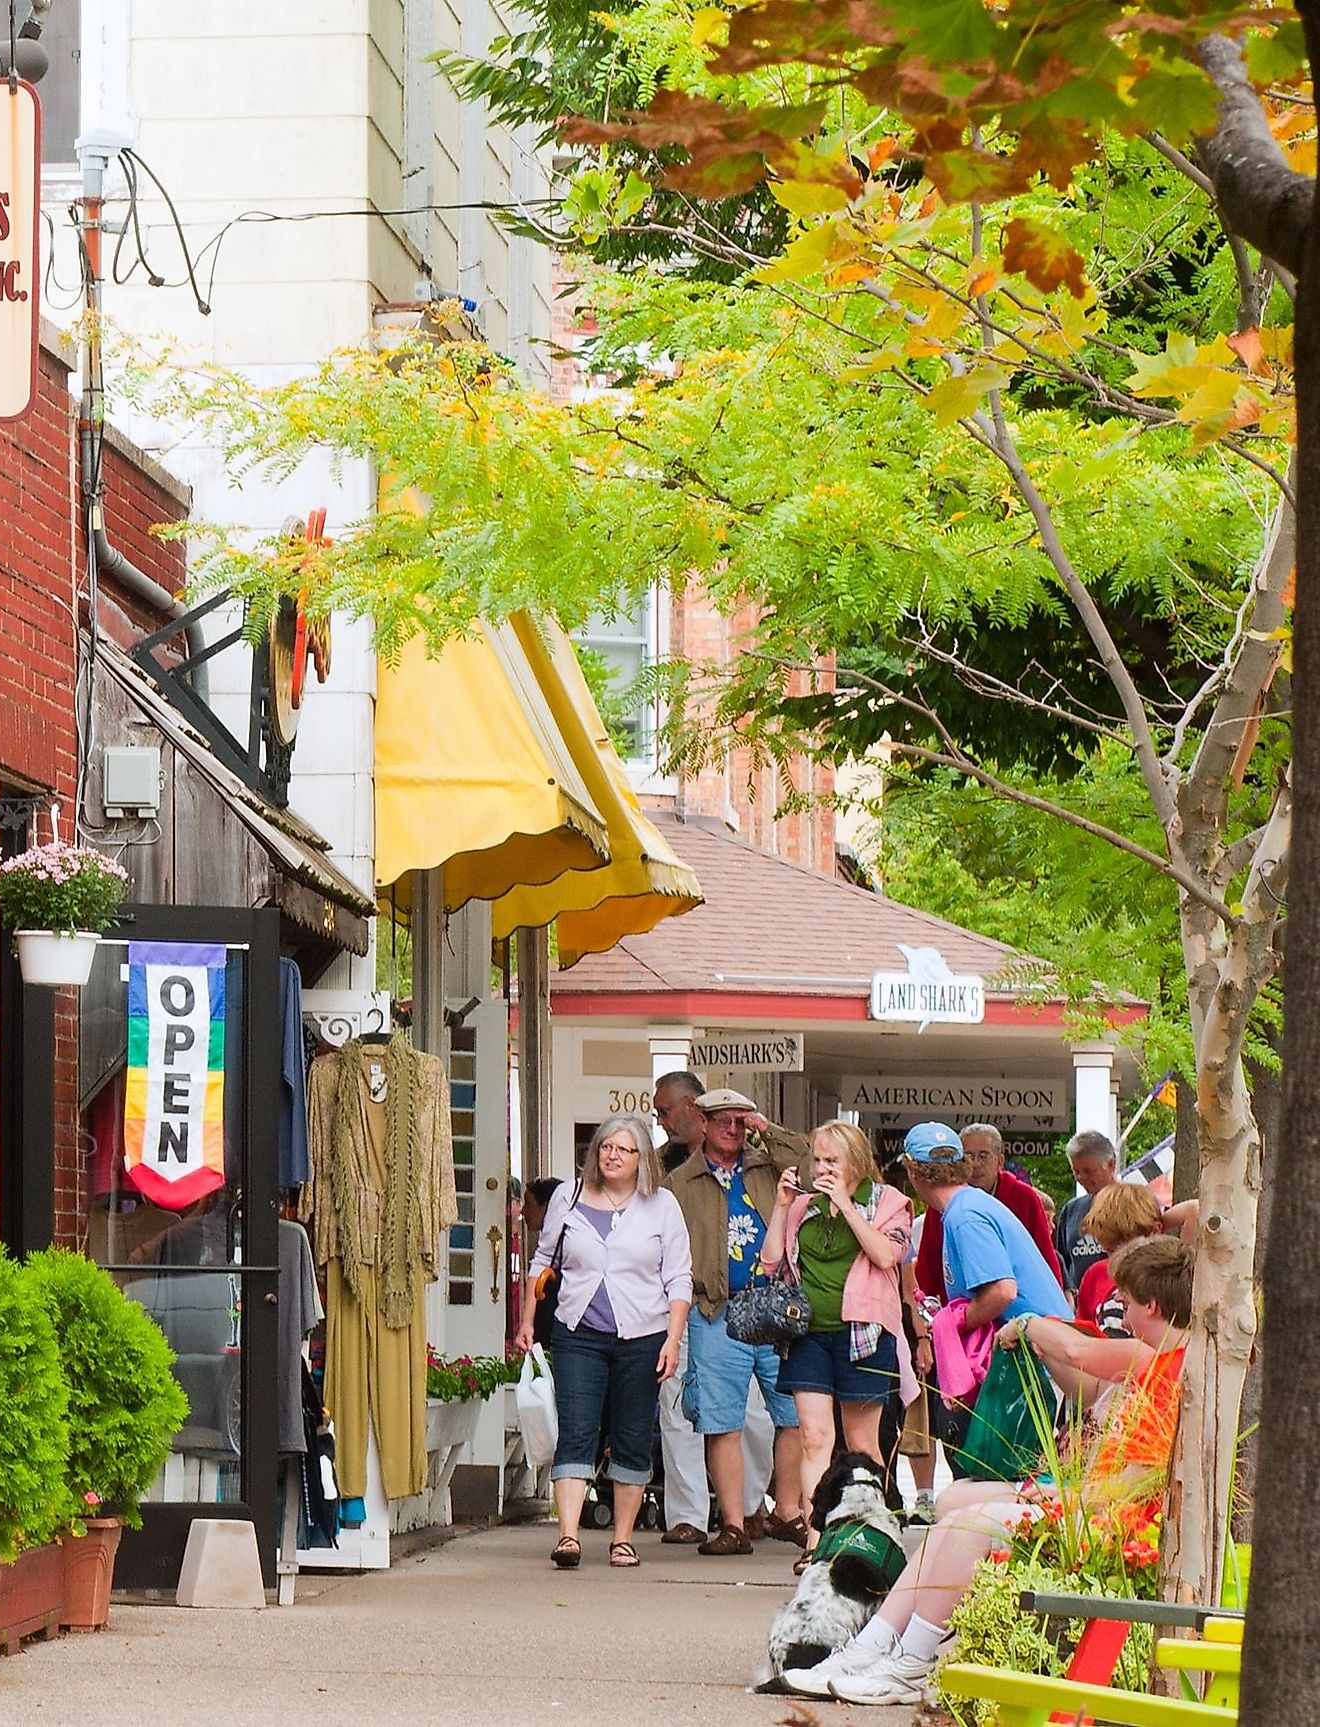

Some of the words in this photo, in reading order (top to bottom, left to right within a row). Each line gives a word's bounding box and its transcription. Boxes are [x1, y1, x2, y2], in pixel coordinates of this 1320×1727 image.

[878, 982, 916, 1014] LAND
[920, 983, 979, 1018] SHARK'S
[688, 1041, 785, 1067] ANDSHARK'S
[157, 974, 196, 1164] OPEN
[609, 1089, 651, 1113] 306
[853, 1083, 974, 1106] AMERICAN
[981, 1085, 1053, 1108] SPOON
[1002, 1141, 1050, 1155] ROOM
